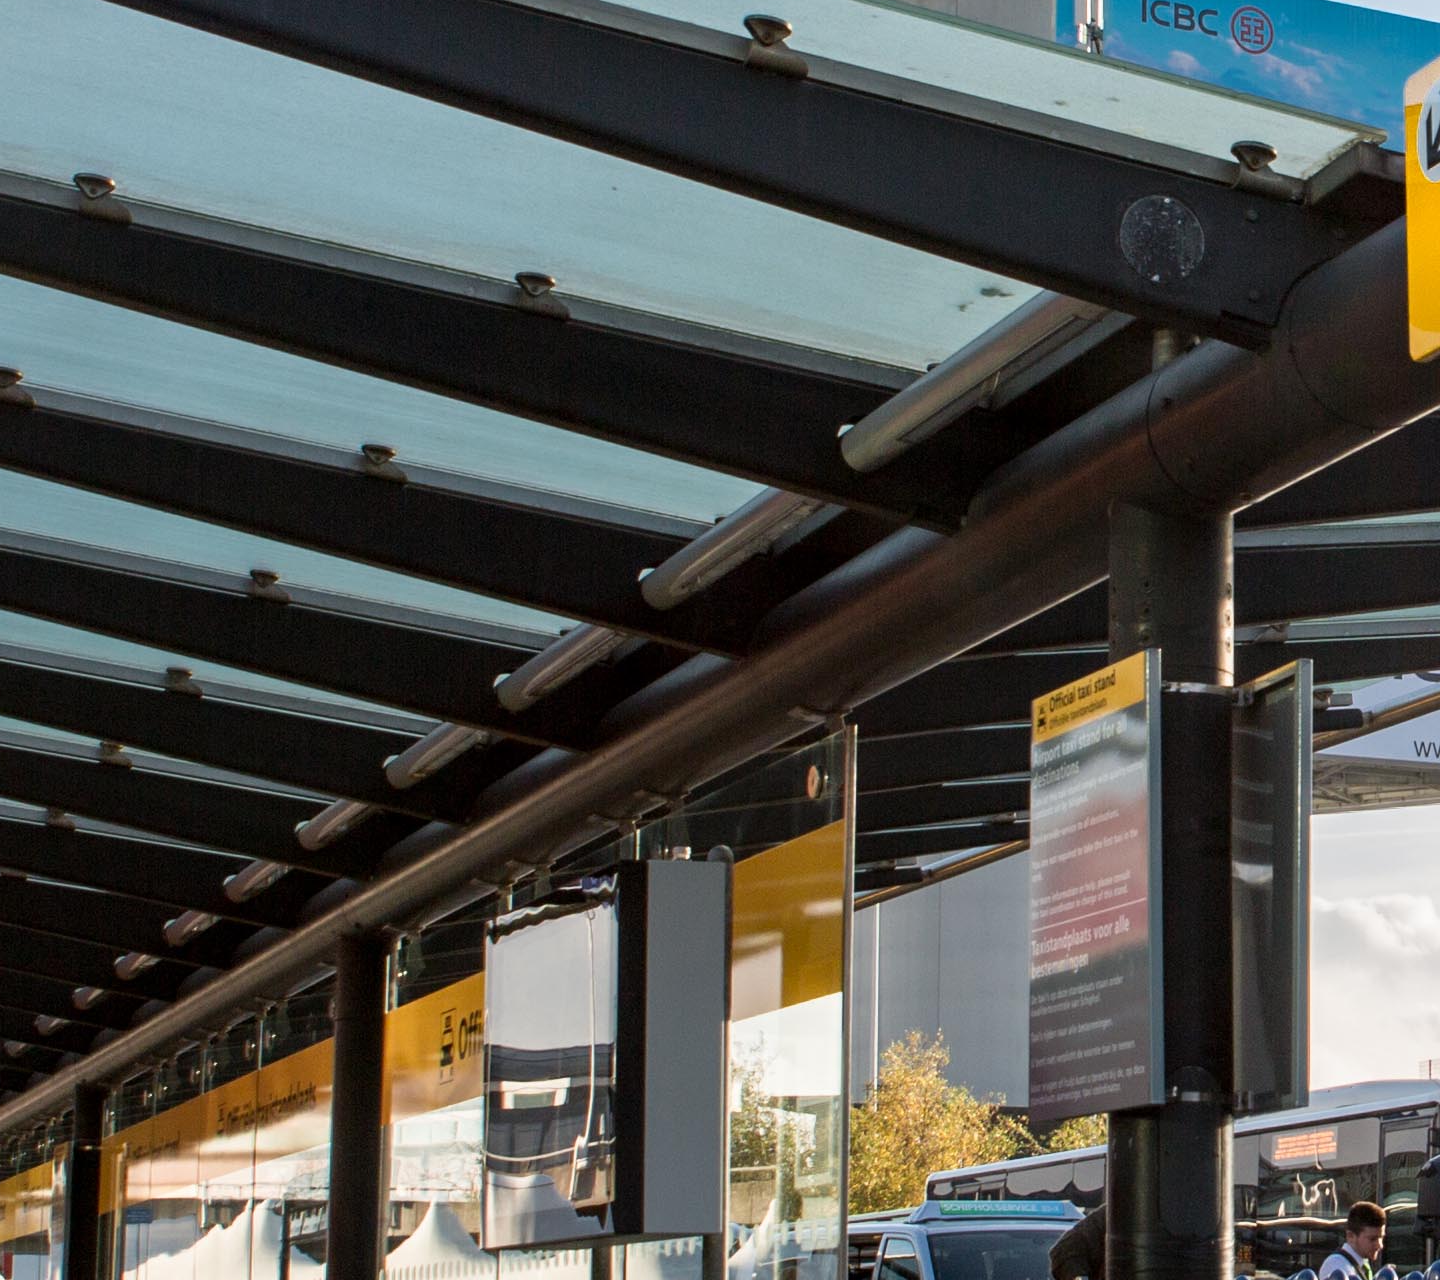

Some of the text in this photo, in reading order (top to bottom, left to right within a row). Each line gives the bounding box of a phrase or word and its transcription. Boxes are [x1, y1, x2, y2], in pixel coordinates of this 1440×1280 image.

[1049, 668, 1115, 712] Official taxi stand
[1061, 735, 1076, 756] taxi
[1078, 724, 1100, 750] stand
[1101, 716, 1114, 742] for
[1031, 914, 1131, 957] Taxistandplaats voor alle
[1031, 952, 1089, 980] bestemmingen
